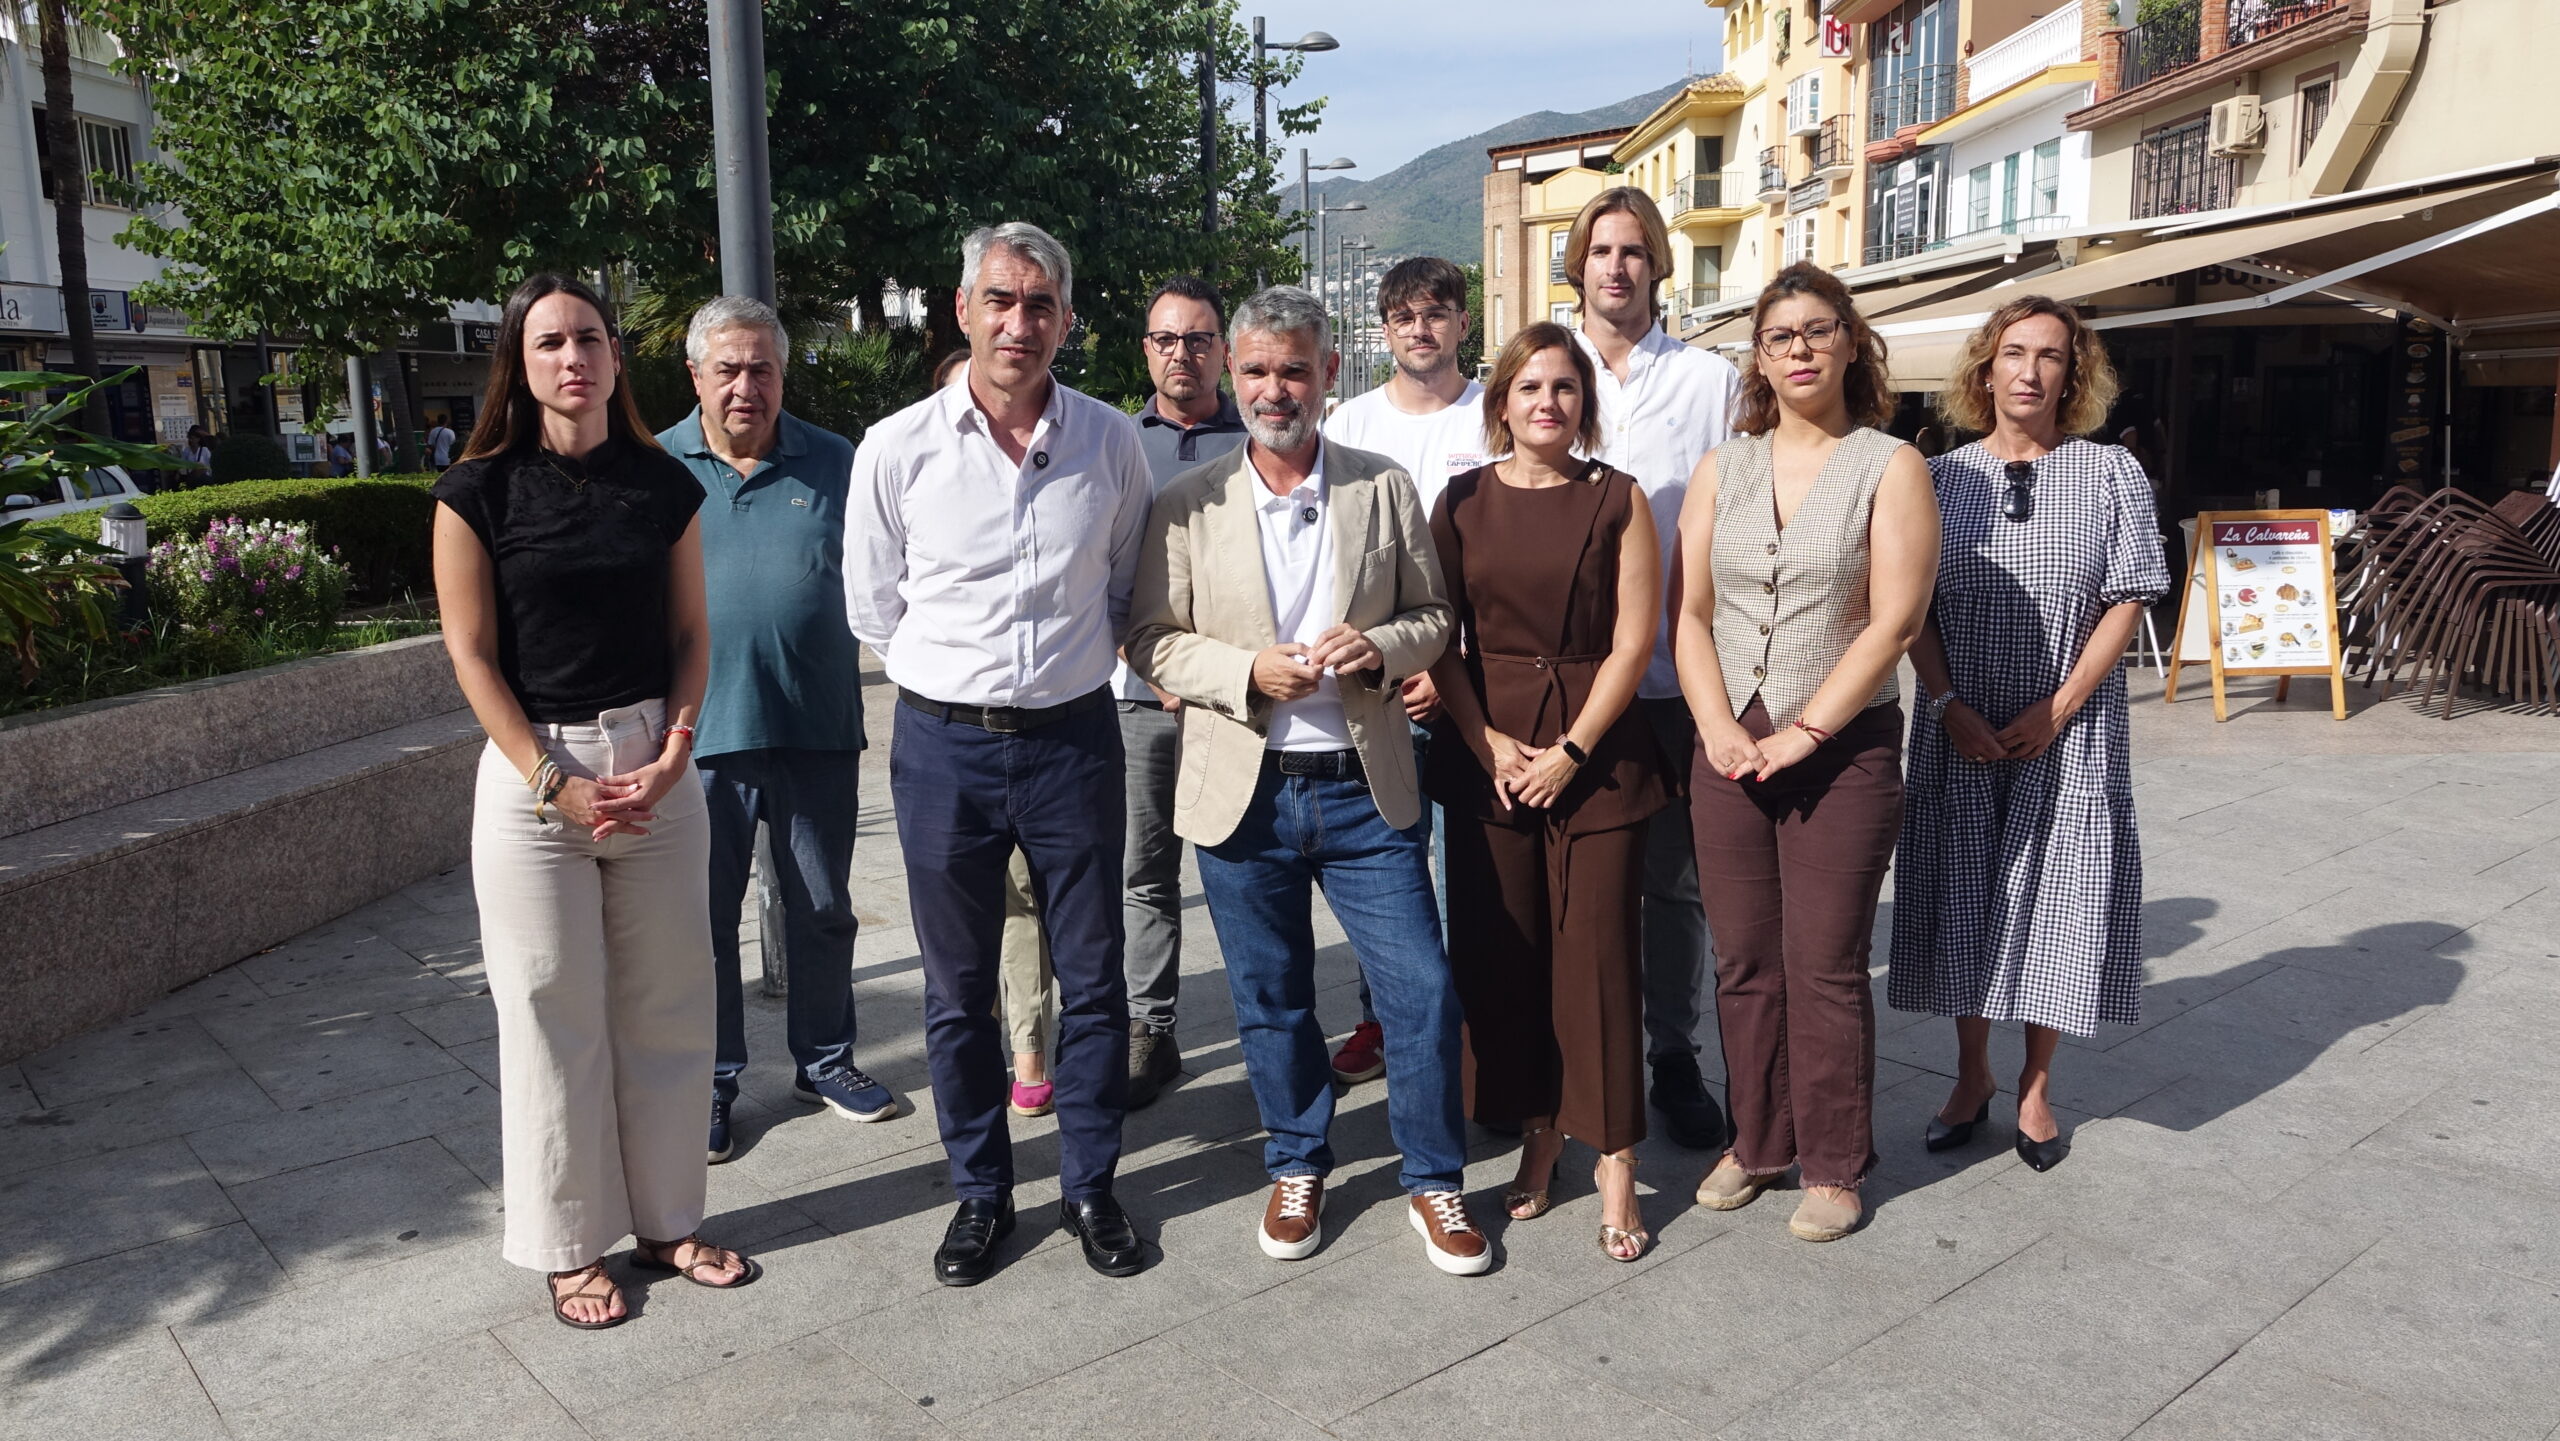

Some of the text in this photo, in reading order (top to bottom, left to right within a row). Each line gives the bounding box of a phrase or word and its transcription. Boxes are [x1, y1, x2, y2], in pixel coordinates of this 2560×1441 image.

[475, 328, 491, 339] CASA
[2221, 526, 2310, 543] La Calvareña
